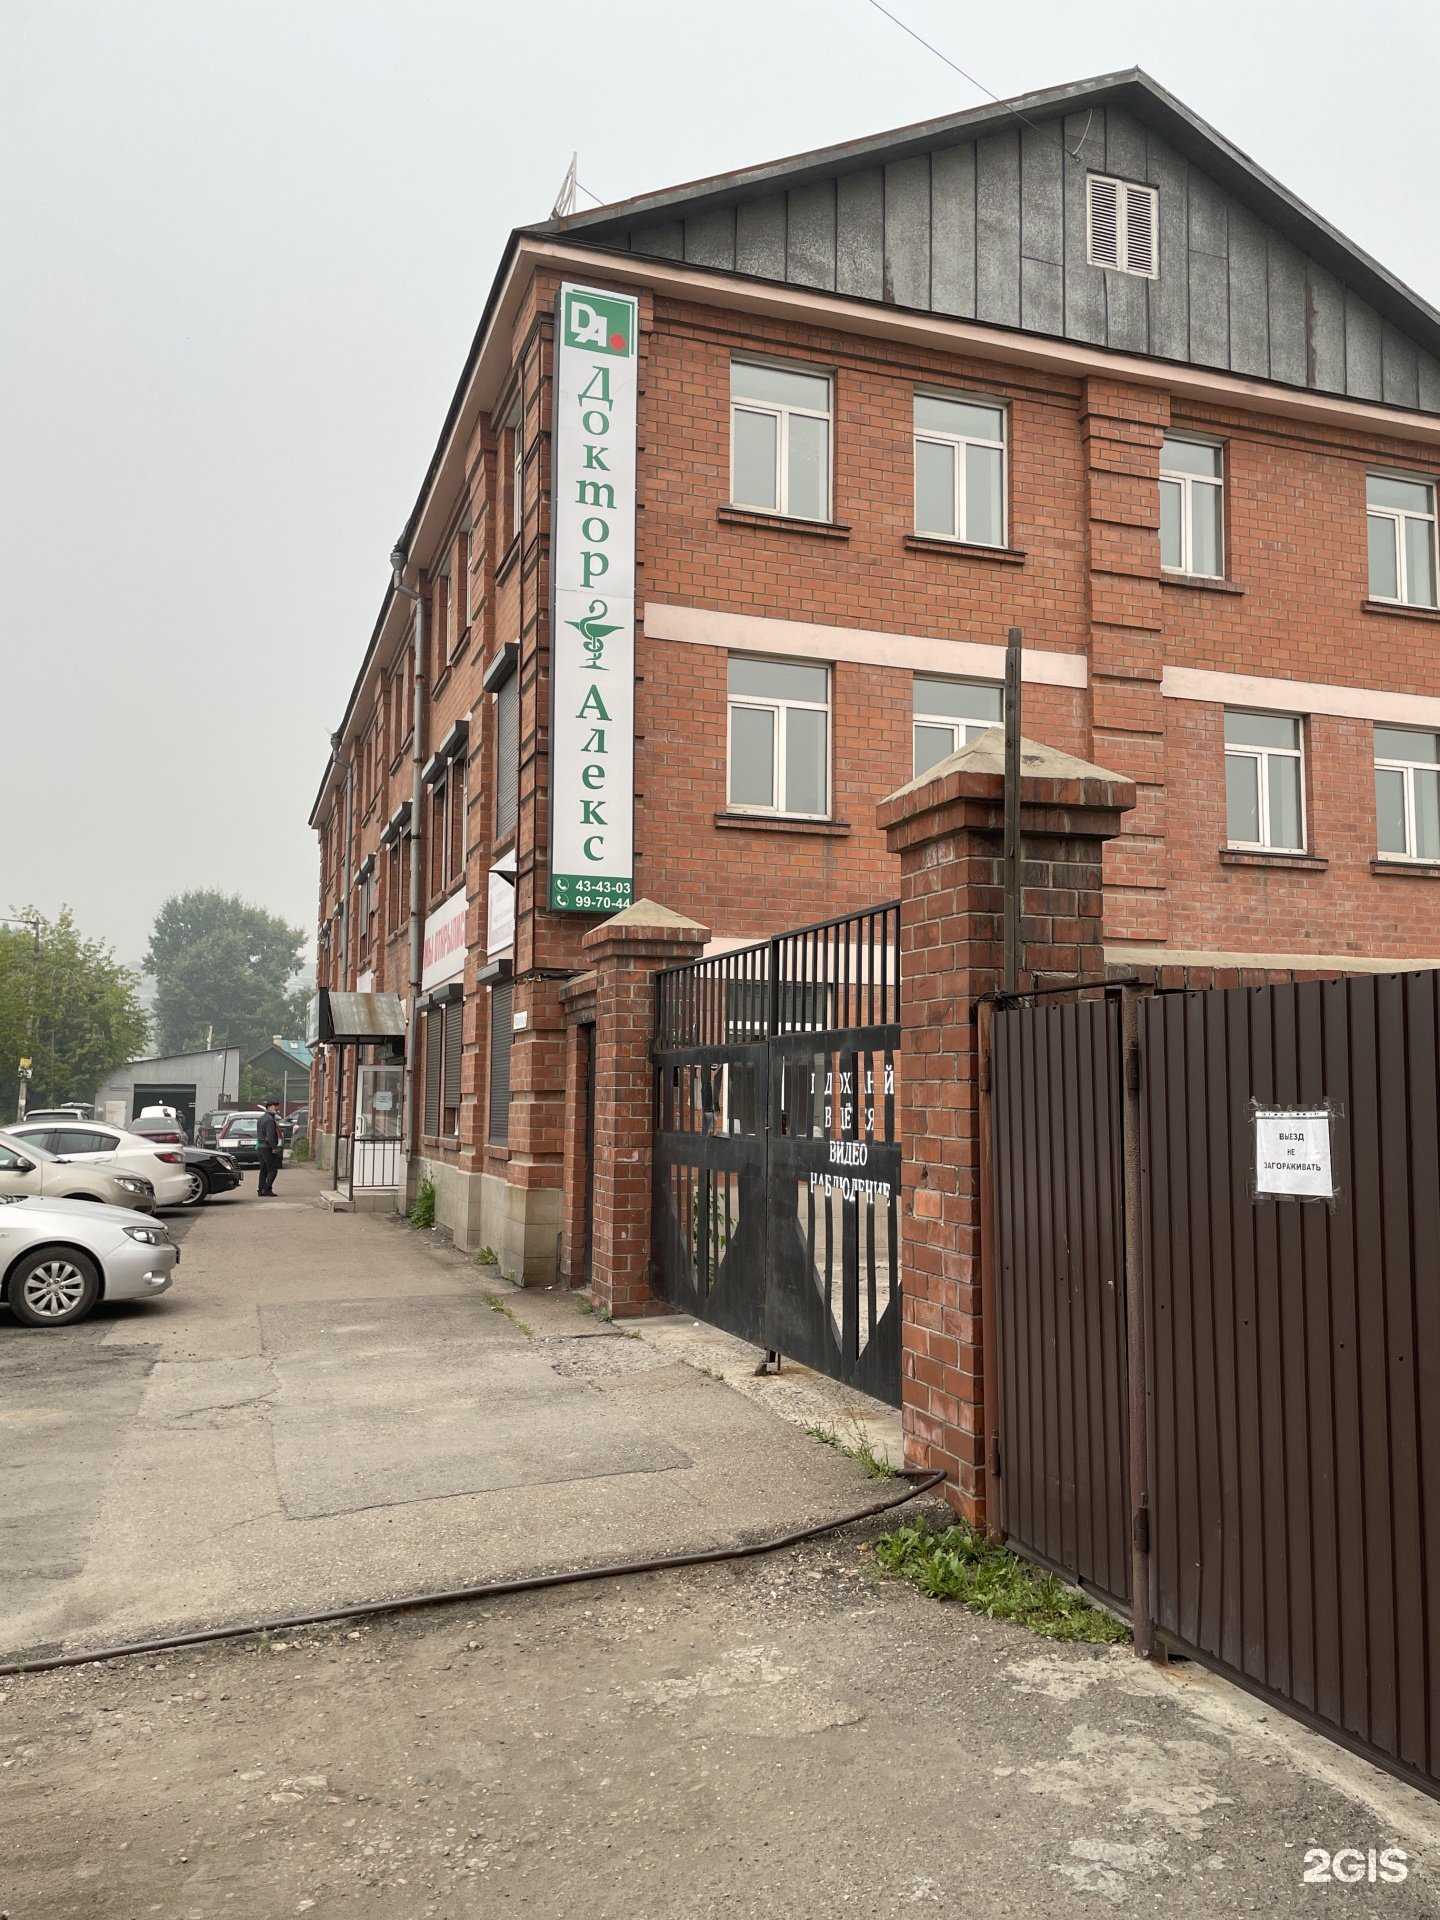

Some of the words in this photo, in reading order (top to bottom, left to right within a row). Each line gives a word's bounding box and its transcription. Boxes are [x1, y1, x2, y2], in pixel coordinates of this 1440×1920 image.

[574, 365, 617, 589] Доктор
[574, 683, 613, 862] Алекс
[575, 879, 631, 894] 43-43-03
[575, 895, 631, 909] 99-70-44
[1279, 1132, 1305, 1142] ВЫЕЗД
[828, 1140, 868, 1166] ВИДЕО
[1287, 1148, 1296, 1156] НЕ
[1263, 1161, 1322, 1172] ЗАГОРАЖИВАТЬ
